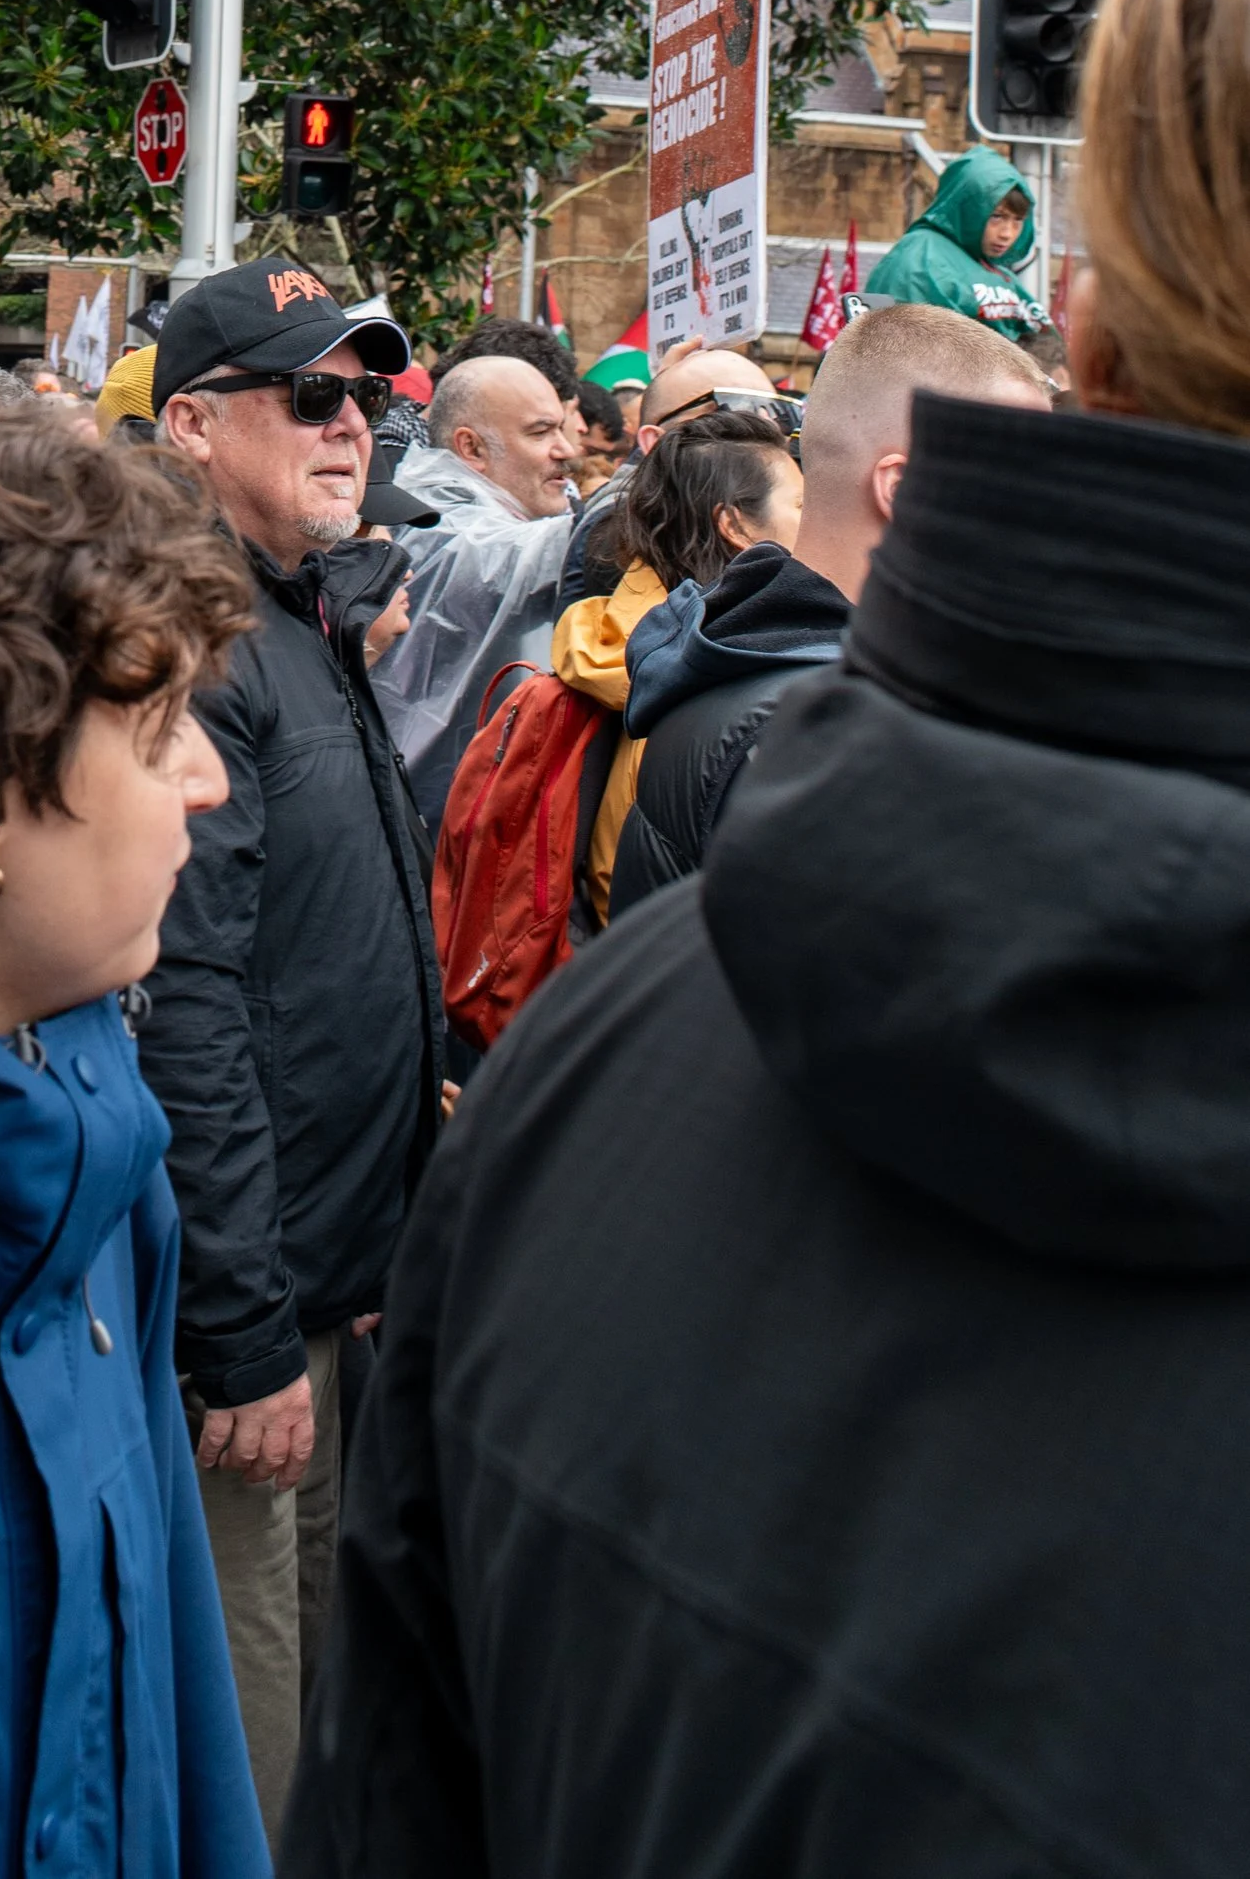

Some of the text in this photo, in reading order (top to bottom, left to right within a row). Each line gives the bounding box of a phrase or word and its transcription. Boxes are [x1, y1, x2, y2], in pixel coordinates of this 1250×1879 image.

[653, 33, 717, 107] STOP THE
[268, 270, 333, 312] SLAYE
